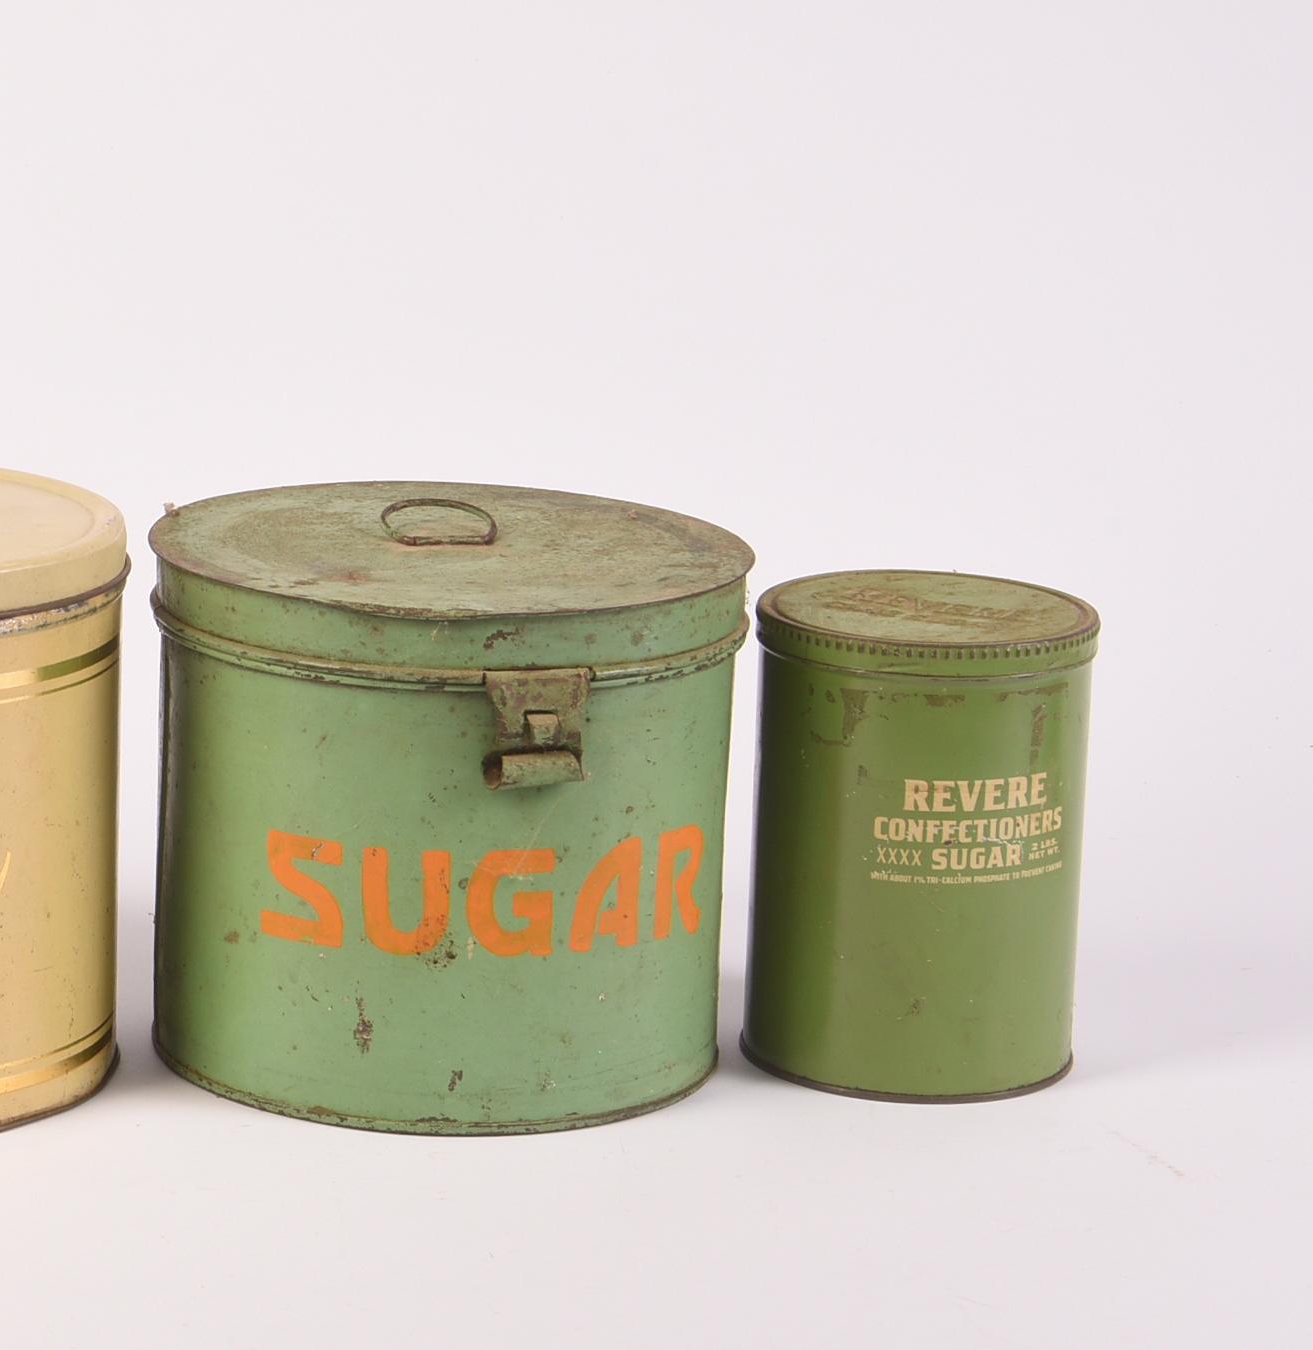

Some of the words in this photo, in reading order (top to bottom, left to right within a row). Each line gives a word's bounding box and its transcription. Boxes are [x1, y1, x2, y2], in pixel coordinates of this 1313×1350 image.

[903, 772, 1048, 812] REVERE
[874, 806, 1063, 843] CONFECTIONERS
[876, 846, 922, 866] XXXX
[931, 844, 1022, 870] SUGAR
[1028, 849, 1045, 861] NET
[1047, 845, 1061, 856] WT.
[1031, 842, 1039, 851] 2
[1040, 837, 1058, 849] LBS.
[259, 824, 705, 957] SUGAR
[870, 871, 888, 881] WITH
[889, 874, 912, 883] ABOUT
[913, 875, 925, 884] 1%
[926, 875, 972, 885] TRI-CALCIUM
[973, 872, 1010, 884] PHOSPHATE
[1012, 871, 1020, 880] TO
